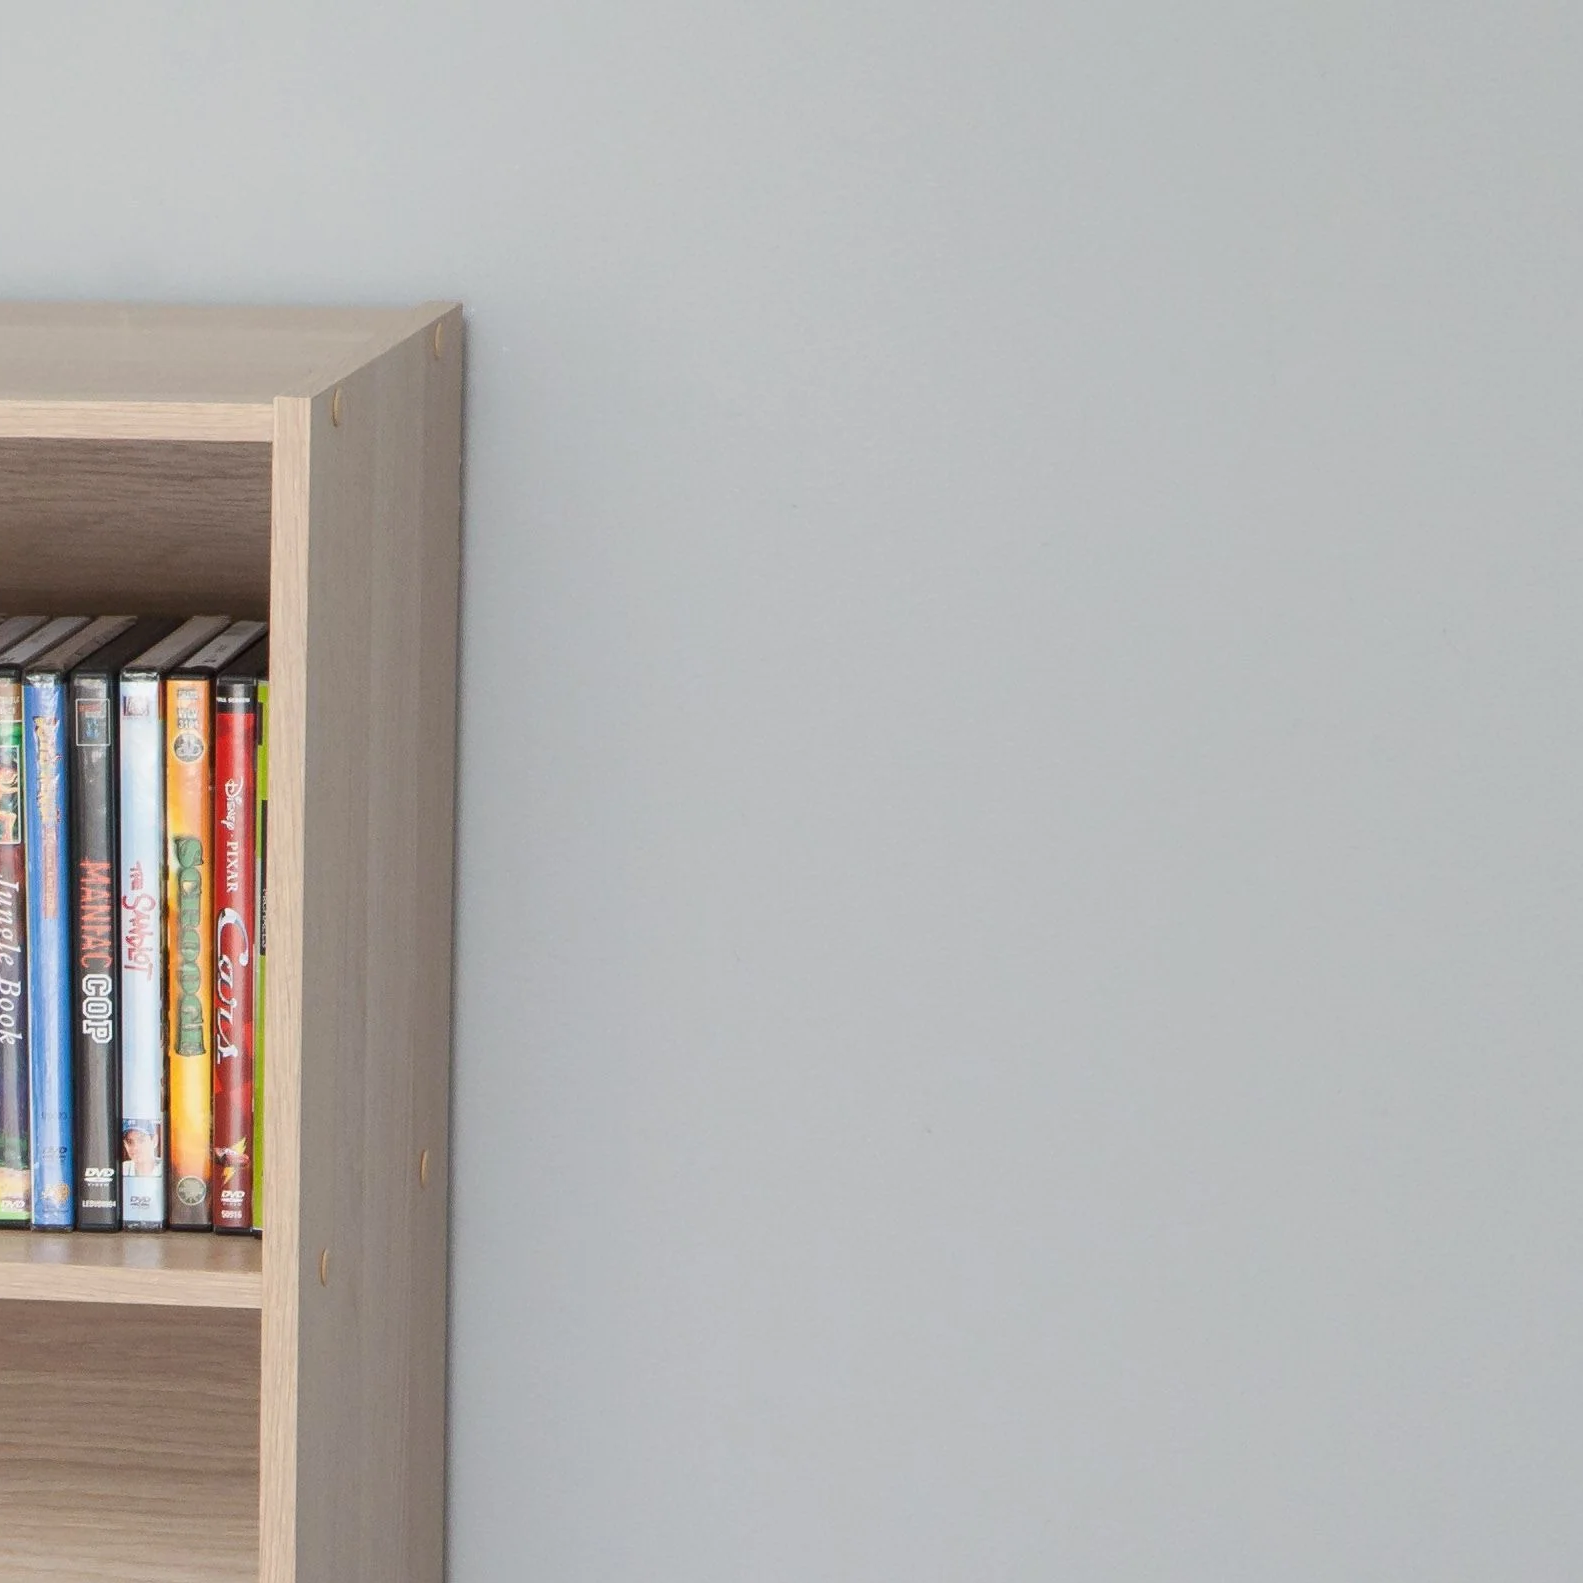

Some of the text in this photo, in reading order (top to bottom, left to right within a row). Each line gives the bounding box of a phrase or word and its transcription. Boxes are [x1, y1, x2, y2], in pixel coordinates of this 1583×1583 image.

[221, 775, 244, 892] Disney PIXAR
[80, 858, 113, 1044] MANIAC COP
[174, 837, 207, 1058] SCROOGE
[217, 908, 249, 1064] Cars
[84, 1168, 115, 1179] DVD
[221, 1191, 245, 1200] DVD
